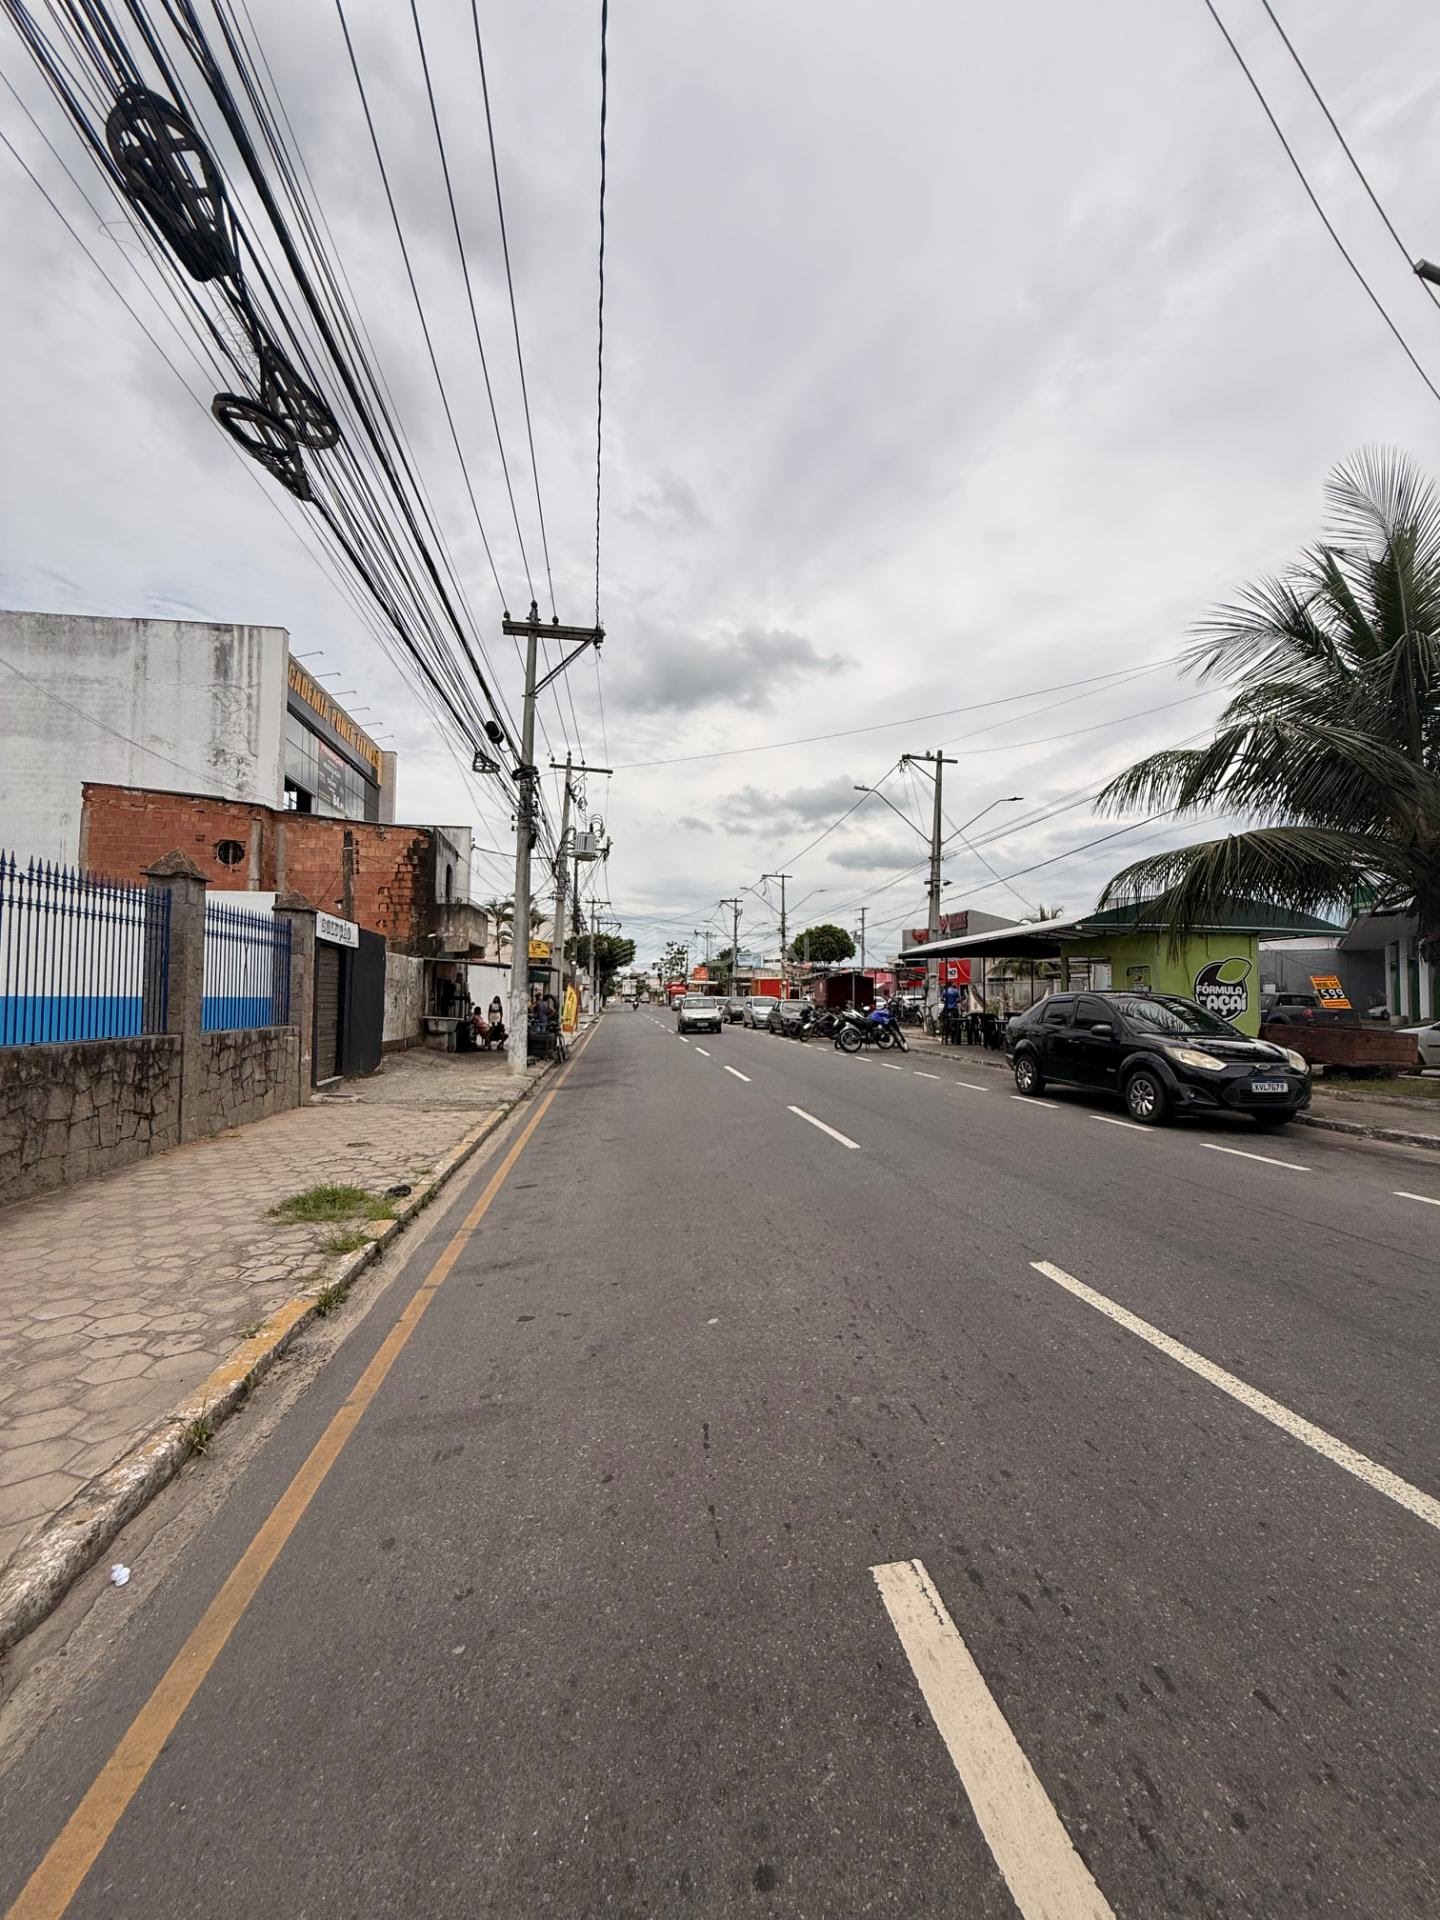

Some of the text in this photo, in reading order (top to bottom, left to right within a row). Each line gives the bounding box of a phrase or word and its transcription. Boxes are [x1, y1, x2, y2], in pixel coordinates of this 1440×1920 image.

[288, 664, 329, 721] CADEMIA
[1196, 982, 1243, 995] FÓRMULA
[1206, 992, 1247, 1016] AÇAÍ
